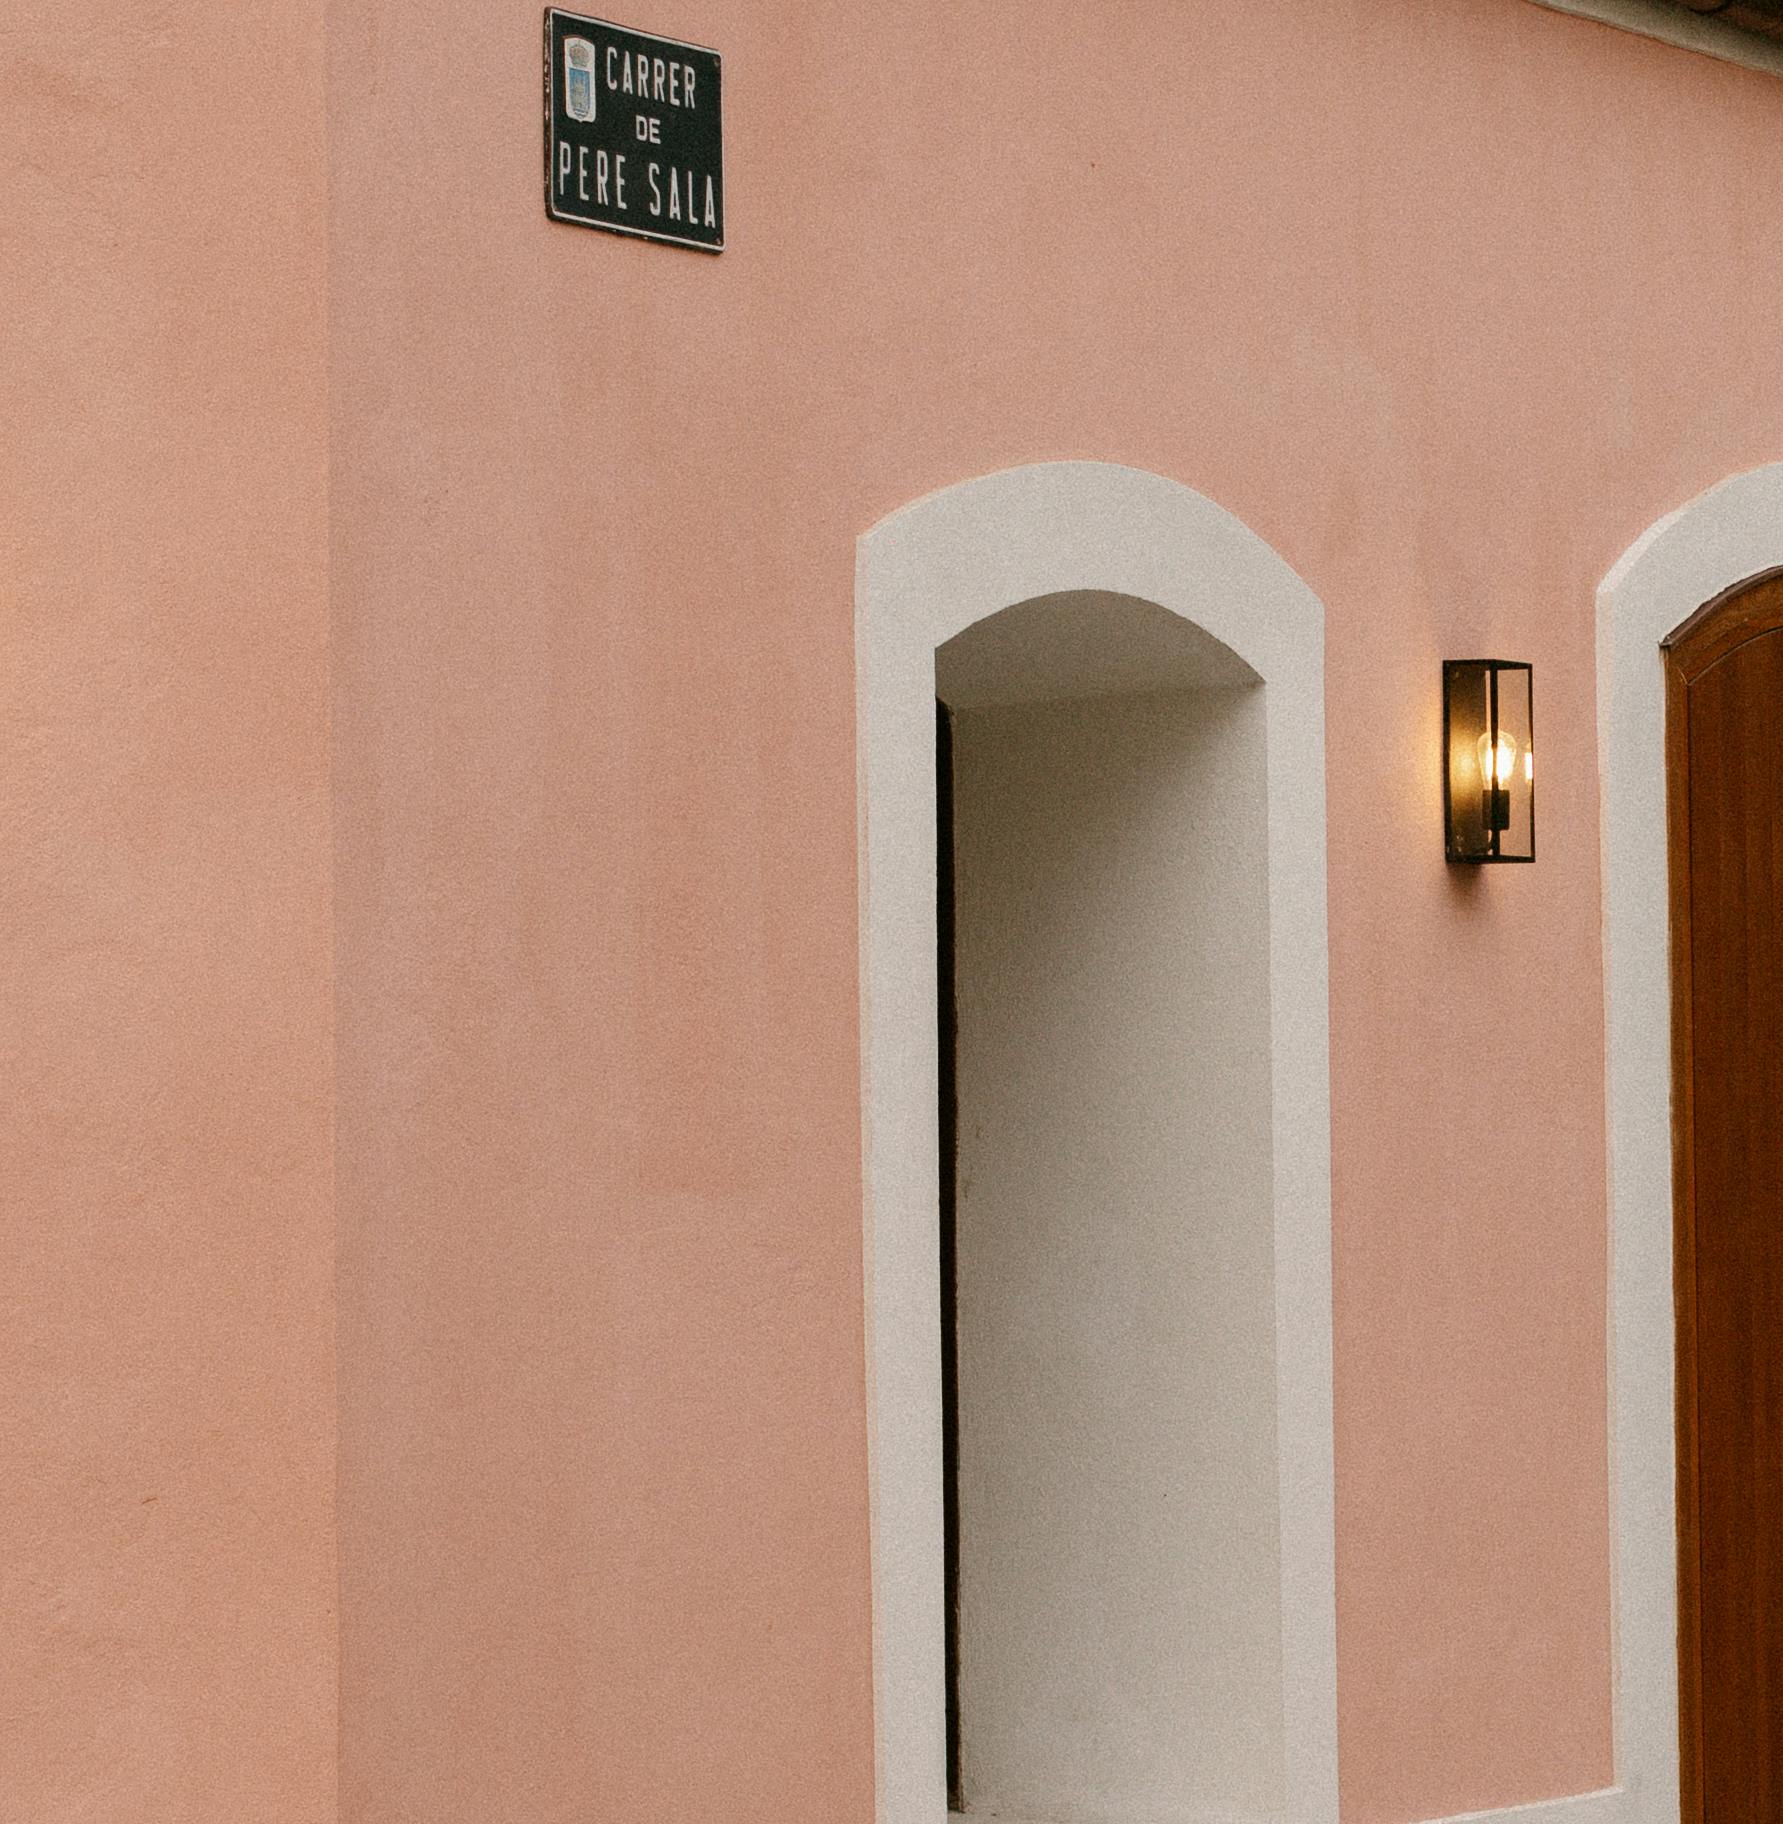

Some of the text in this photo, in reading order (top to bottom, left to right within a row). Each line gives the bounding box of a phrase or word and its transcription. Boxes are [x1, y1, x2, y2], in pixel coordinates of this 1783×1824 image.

[606, 46, 696, 109] CARRER
[635, 114, 661, 145] DE
[559, 140, 716, 229] PERE SALA
